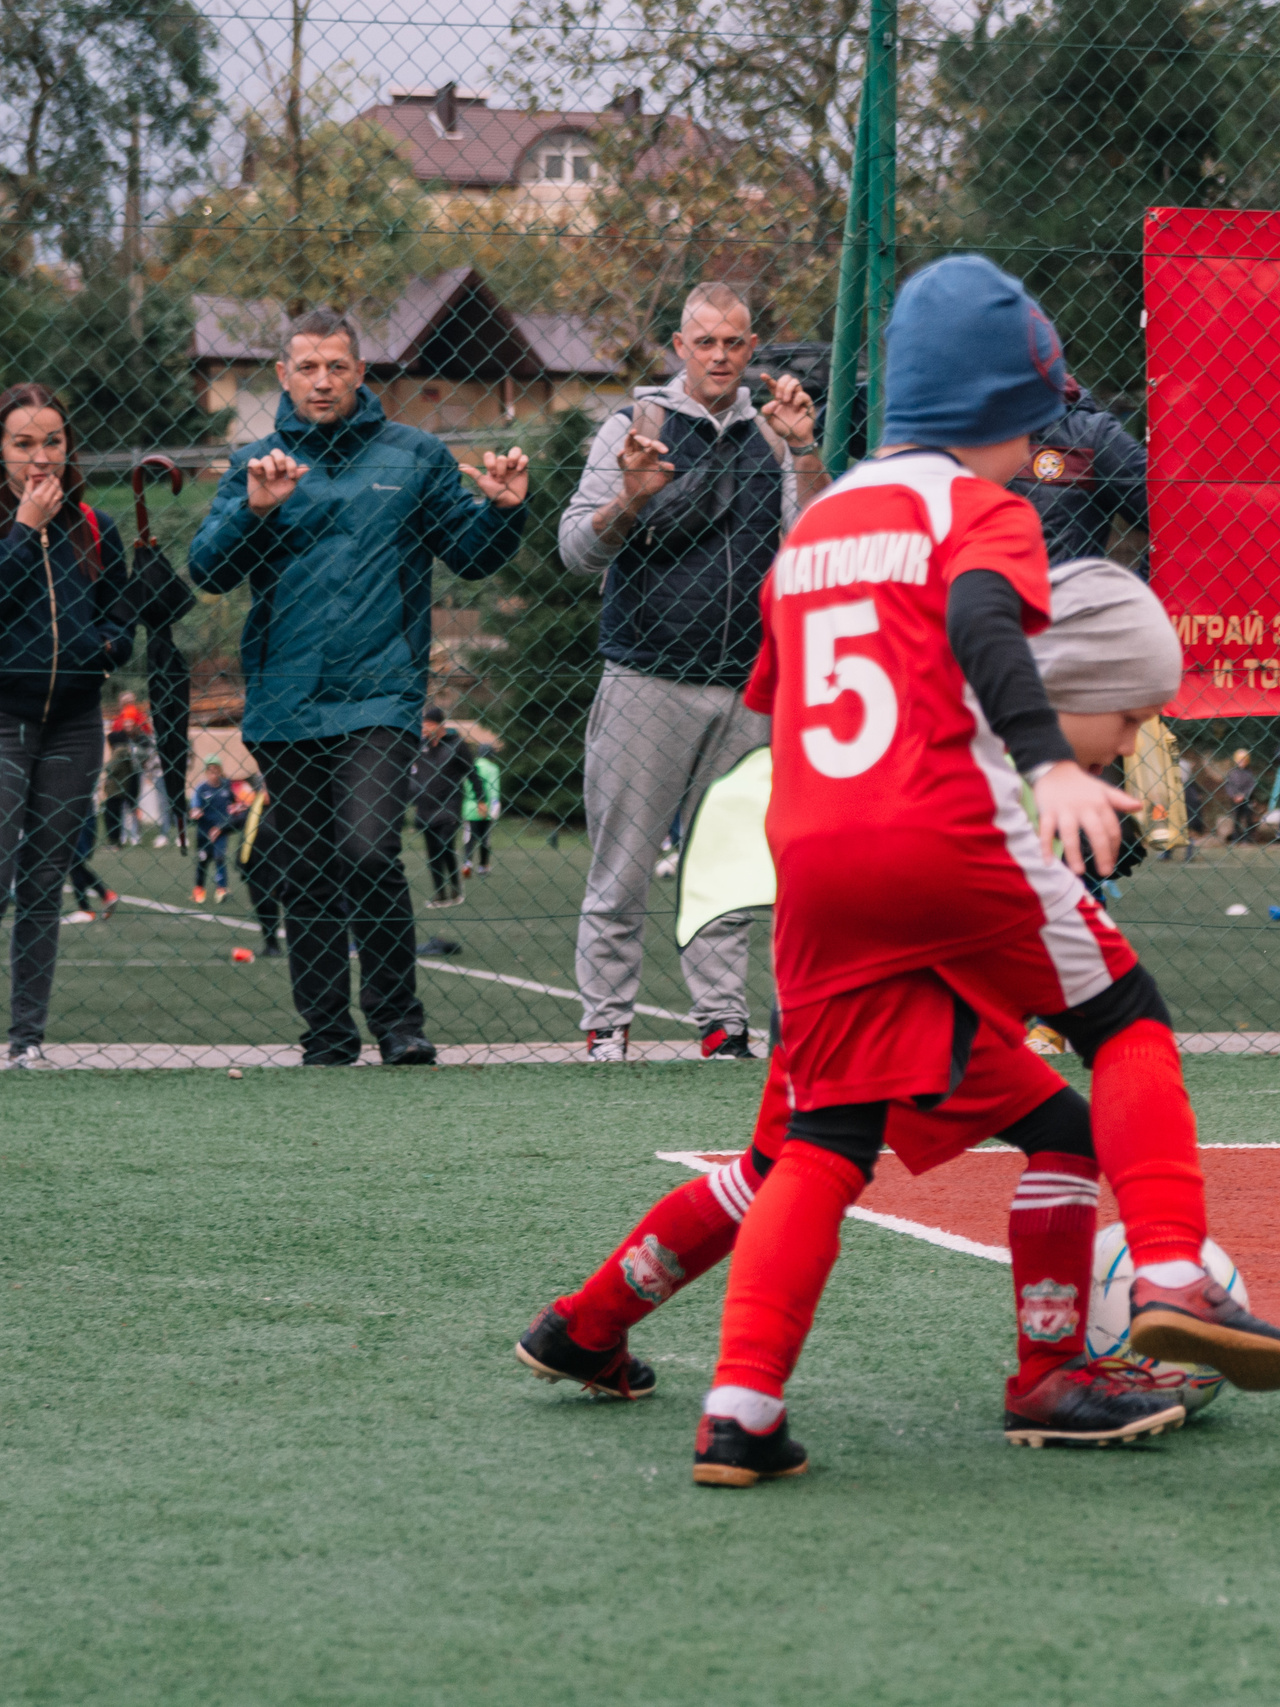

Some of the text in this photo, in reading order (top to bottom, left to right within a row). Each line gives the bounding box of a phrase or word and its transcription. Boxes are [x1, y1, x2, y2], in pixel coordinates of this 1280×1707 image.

[1171, 610, 1264, 645] ИГРАЙ
[800, 598, 898, 779] 5
[1213, 659, 1234, 688] И
